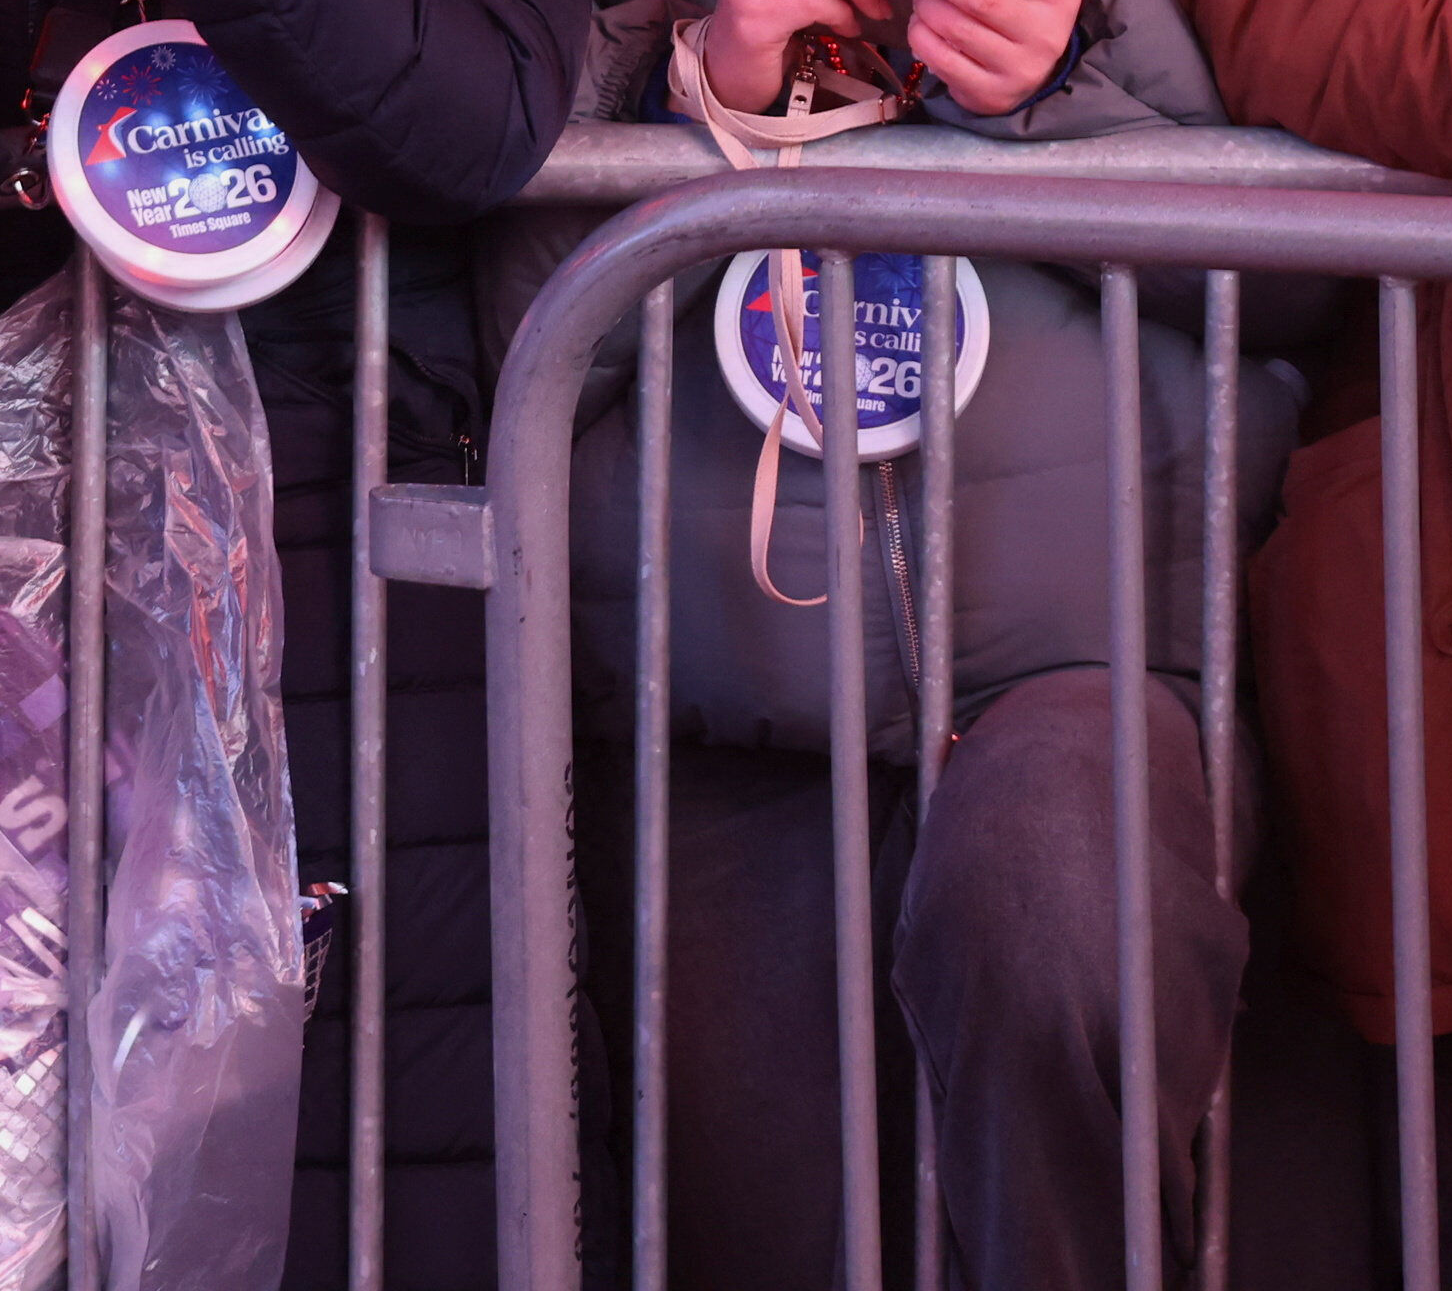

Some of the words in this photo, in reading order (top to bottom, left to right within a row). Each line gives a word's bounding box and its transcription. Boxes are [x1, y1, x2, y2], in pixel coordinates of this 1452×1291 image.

[127, 107, 276, 155] Carniva
[183, 148, 207, 169] is
[207, 132, 290, 164] calling
[126, 185, 168, 210] New
[131, 204, 173, 228] Year
[169, 220, 208, 239] Times
[206, 211, 252, 233] Square
[869, 330, 922, 353] calli
